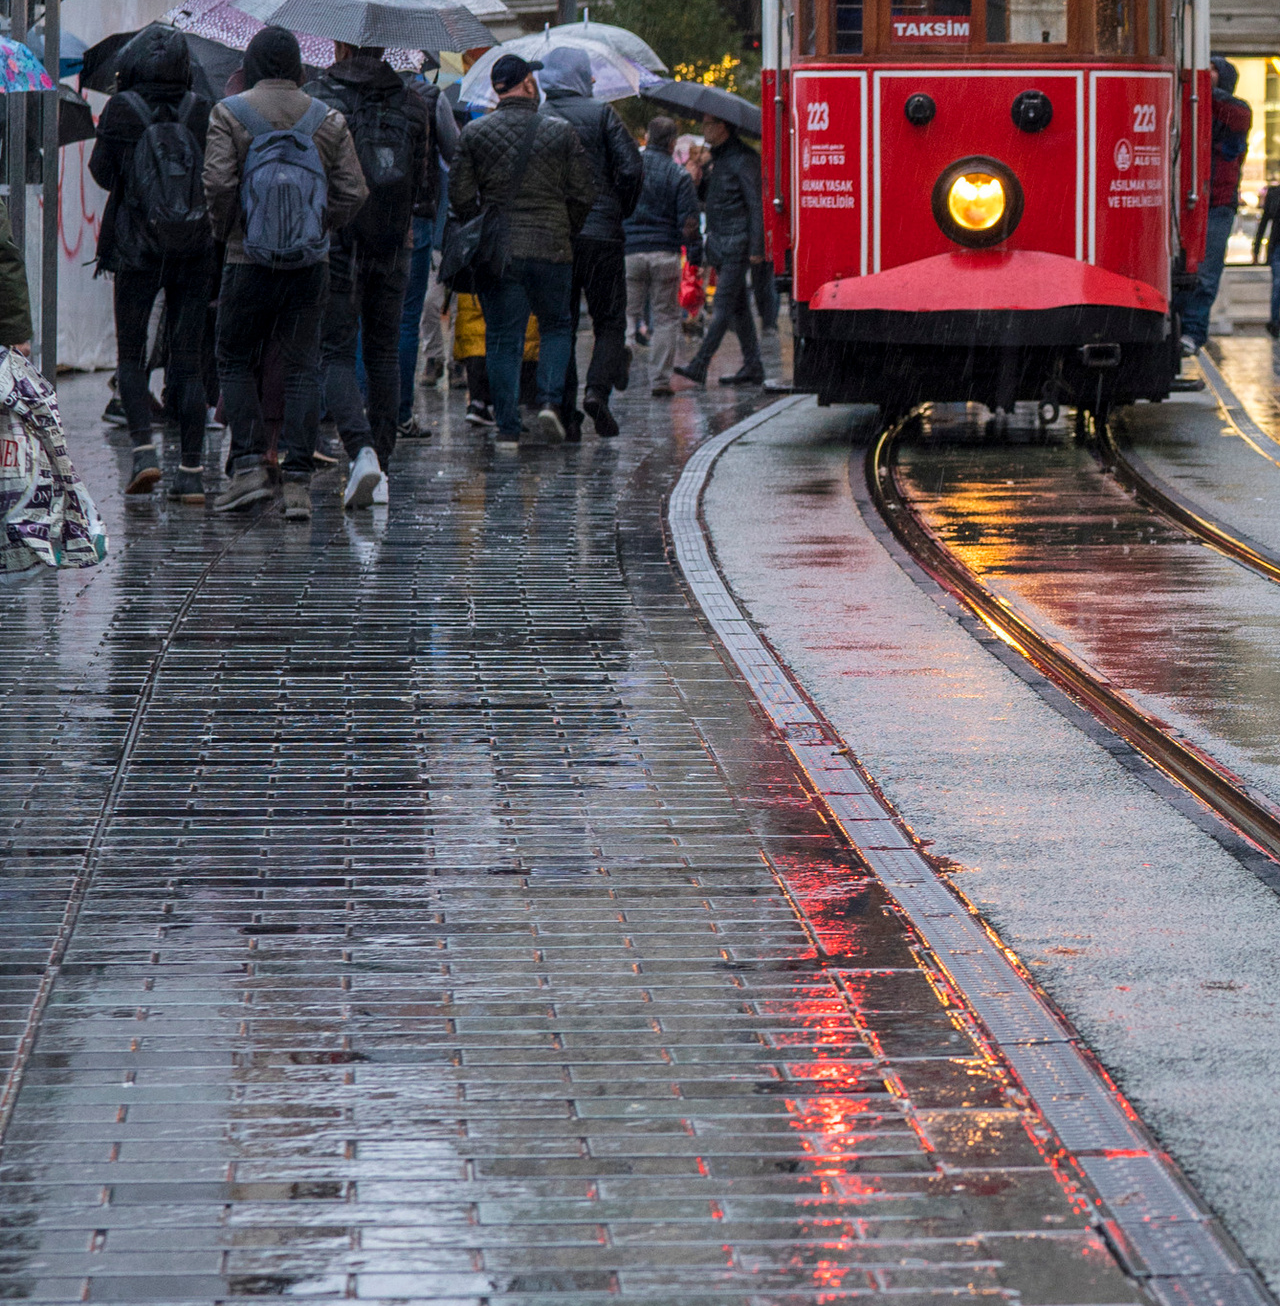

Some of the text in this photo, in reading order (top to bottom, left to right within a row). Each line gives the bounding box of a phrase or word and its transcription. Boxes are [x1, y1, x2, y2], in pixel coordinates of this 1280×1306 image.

[893, 20, 970, 36] TAKSİM
[807, 102, 829, 131] 223
[1133, 104, 1156, 132] 223
